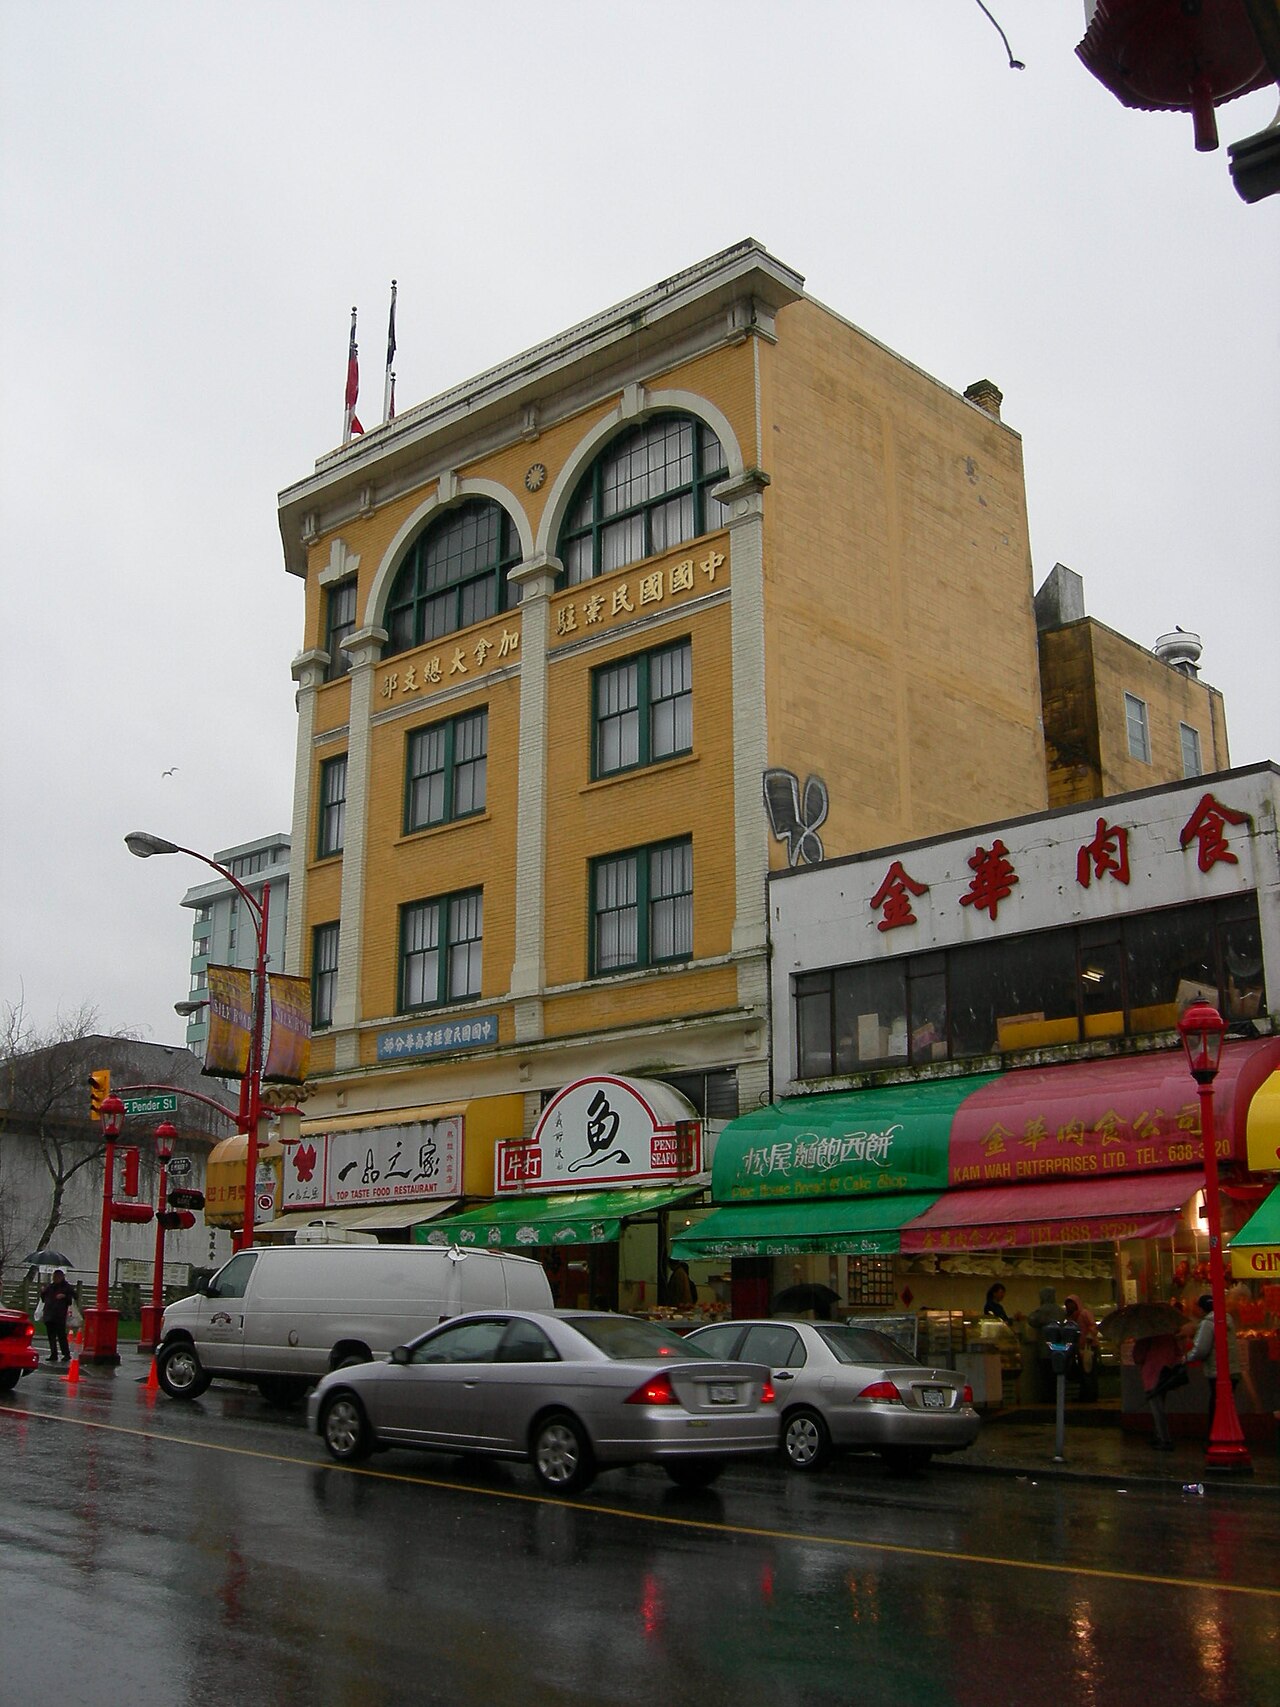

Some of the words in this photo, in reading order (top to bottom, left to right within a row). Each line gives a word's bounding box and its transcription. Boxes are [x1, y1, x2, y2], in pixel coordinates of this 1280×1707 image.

[870, 792, 1250, 932] 金華肉食
[132, 1100, 160, 1112] Pender
[163, 1098, 173, 1110] St
[953, 1165, 980, 1183] KAM
[985, 1161, 1011, 1179] WAH
[1016, 1154, 1097, 1177] ENTERPRISES
[1103, 1150, 1128, 1169] LTD.
[1136, 1147, 1163, 1165] TEL:
[336, 1190, 348, 1200] TOP
[351, 1189, 370, 1199] TASTE
[373, 1187, 390, 1197] FOOD
[394, 1183, 438, 1195] RESTAURANT
